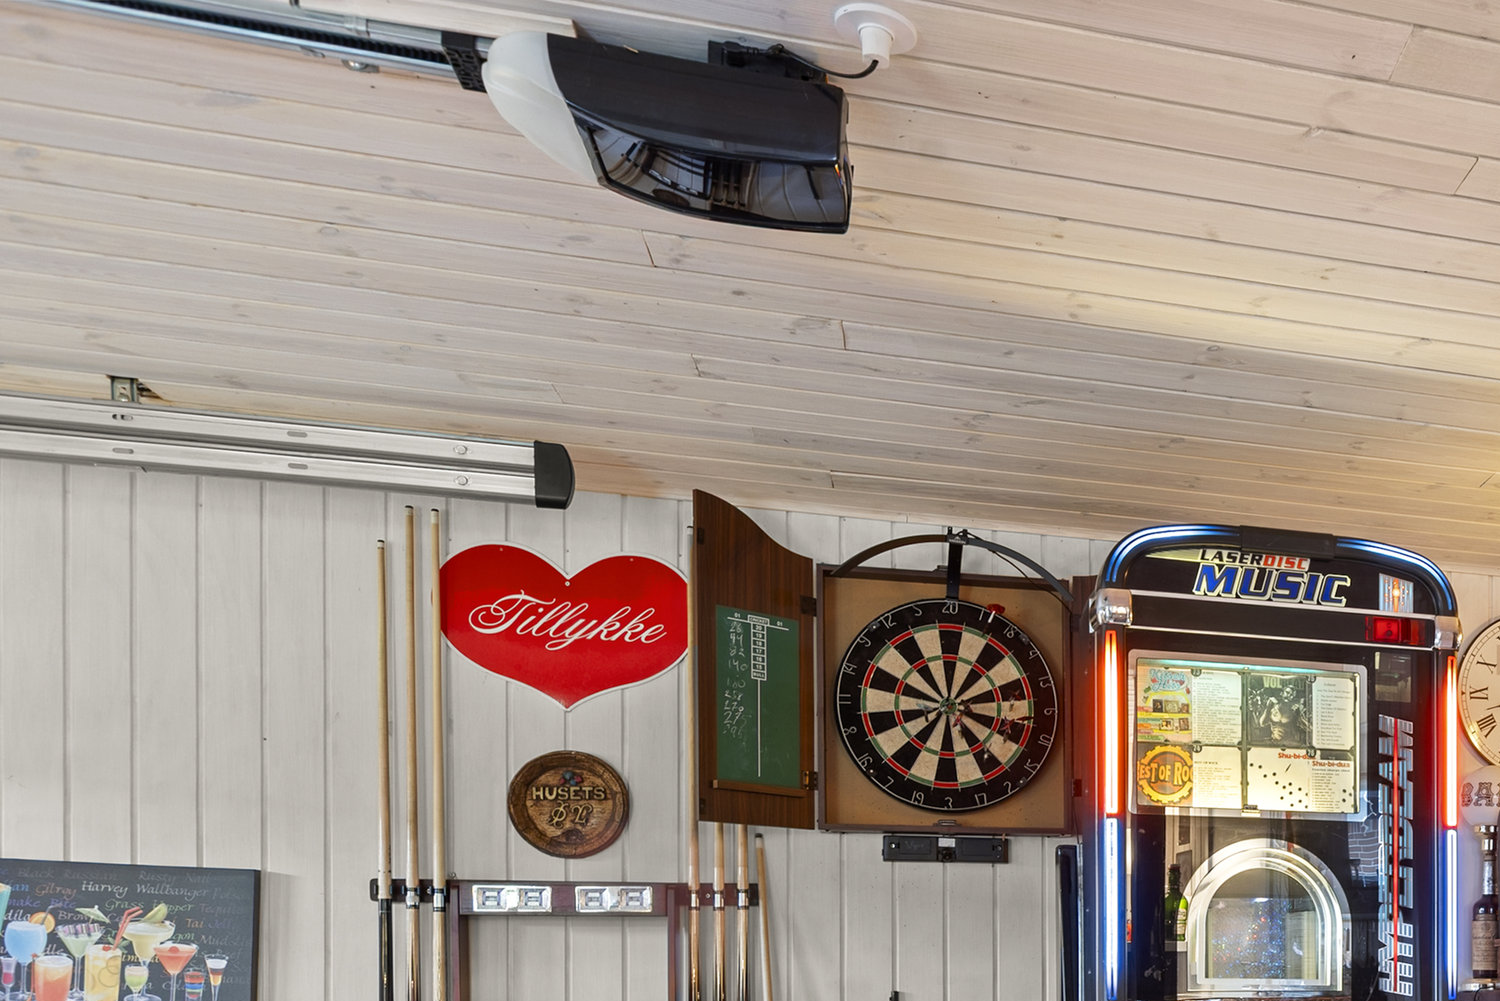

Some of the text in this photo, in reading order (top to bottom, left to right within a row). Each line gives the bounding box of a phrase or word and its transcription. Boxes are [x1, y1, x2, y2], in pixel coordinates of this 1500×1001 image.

[1200, 549, 1310, 571] LASERDISC
[1192, 563, 1351, 607] MUSIC
[942, 600, 959, 614] 20
[469, 590, 667, 651] Tillykke
[880, 613, 896, 629] 12
[1003, 625, 1018, 639] 18
[1476, 654, 1497, 674] X
[1038, 675, 1054, 688] 13
[837, 693, 852, 704] 11
[1469, 686, 1489, 700] IX
[1038, 733, 1052, 747] 10
[1024, 758, 1040, 774] 15
[1159, 763, 1171, 782] OF
[532, 786, 606, 801] HUSETS
[911, 790, 925, 806] 19
[974, 792, 988, 806] 17
[82, 880, 128, 898] Harvey
[136, 883, 210, 900] Wallbanger
